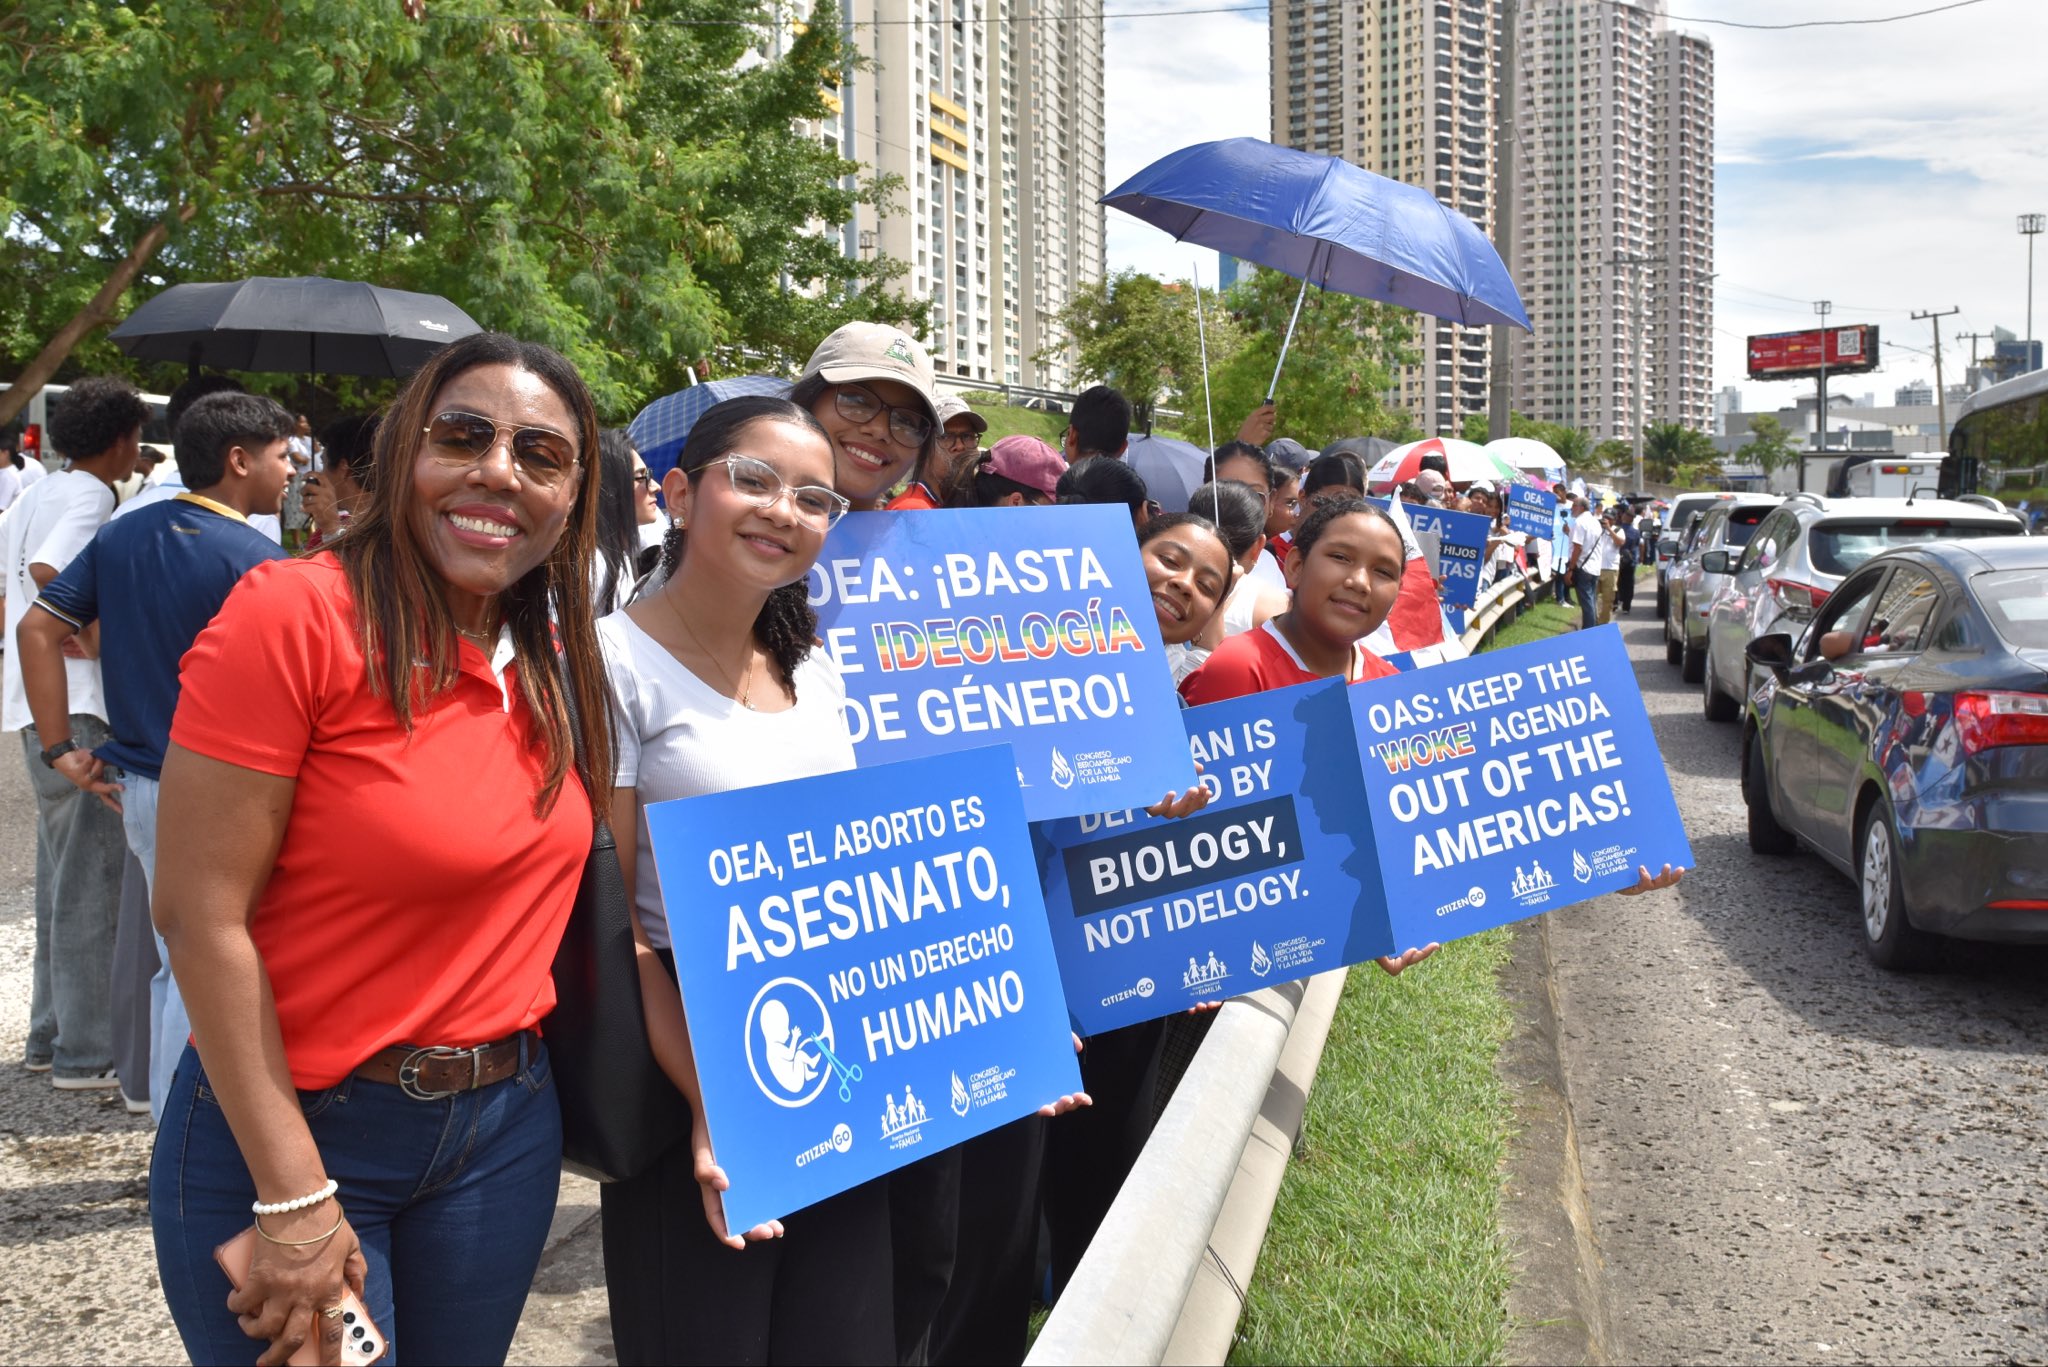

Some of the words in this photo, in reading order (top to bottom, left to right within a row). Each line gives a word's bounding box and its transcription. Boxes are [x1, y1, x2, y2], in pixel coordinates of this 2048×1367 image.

[1510, 507, 1520, 517] NO
[1521, 510, 1529, 520] TE
[1530, 513, 1552, 526] METAS
[1524, 491, 1544, 506] OEA:
[934, 547, 1112, 609] ¡BASTA
[1440, 560, 1476, 579] TAS
[1444, 544, 1478, 559] HIJOS
[826, 627, 864, 674] E
[872, 597, 1145, 673] IDEOLOGÍA
[845, 693, 907, 744] DE
[916, 673, 1135, 736] GÉNERO!
[1368, 694, 1444, 734] OAS:
[1447, 671, 1523, 715] KEEP
[1528, 655, 1592, 692] THE
[1489, 692, 1611, 747] AGENDA
[1243, 718, 1277, 753] IS
[1231, 758, 1273, 798] BY
[1388, 767, 1470, 824] OUT
[1481, 752, 1533, 798] OF
[1537, 730, 1622, 782] THE
[708, 840, 784, 887] OEA,
[787, 830, 826, 868] EL
[833, 803, 946, 860] ABORTO
[953, 796, 985, 833] ES
[1089, 815, 1287, 896] BIOLOGY,
[1413, 779, 1632, 877] AMERICAS!
[726, 846, 1010, 972] ASESINATO,
[1084, 907, 1153, 952] NOT
[1163, 869, 1309, 933] IDELOGY.
[828, 966, 866, 1003] NO
[870, 955, 906, 991] UN
[912, 922, 1014, 978] DERECHO
[862, 970, 1025, 1063] HUMANO
[898, 1132, 922, 1150] FAMILIA
